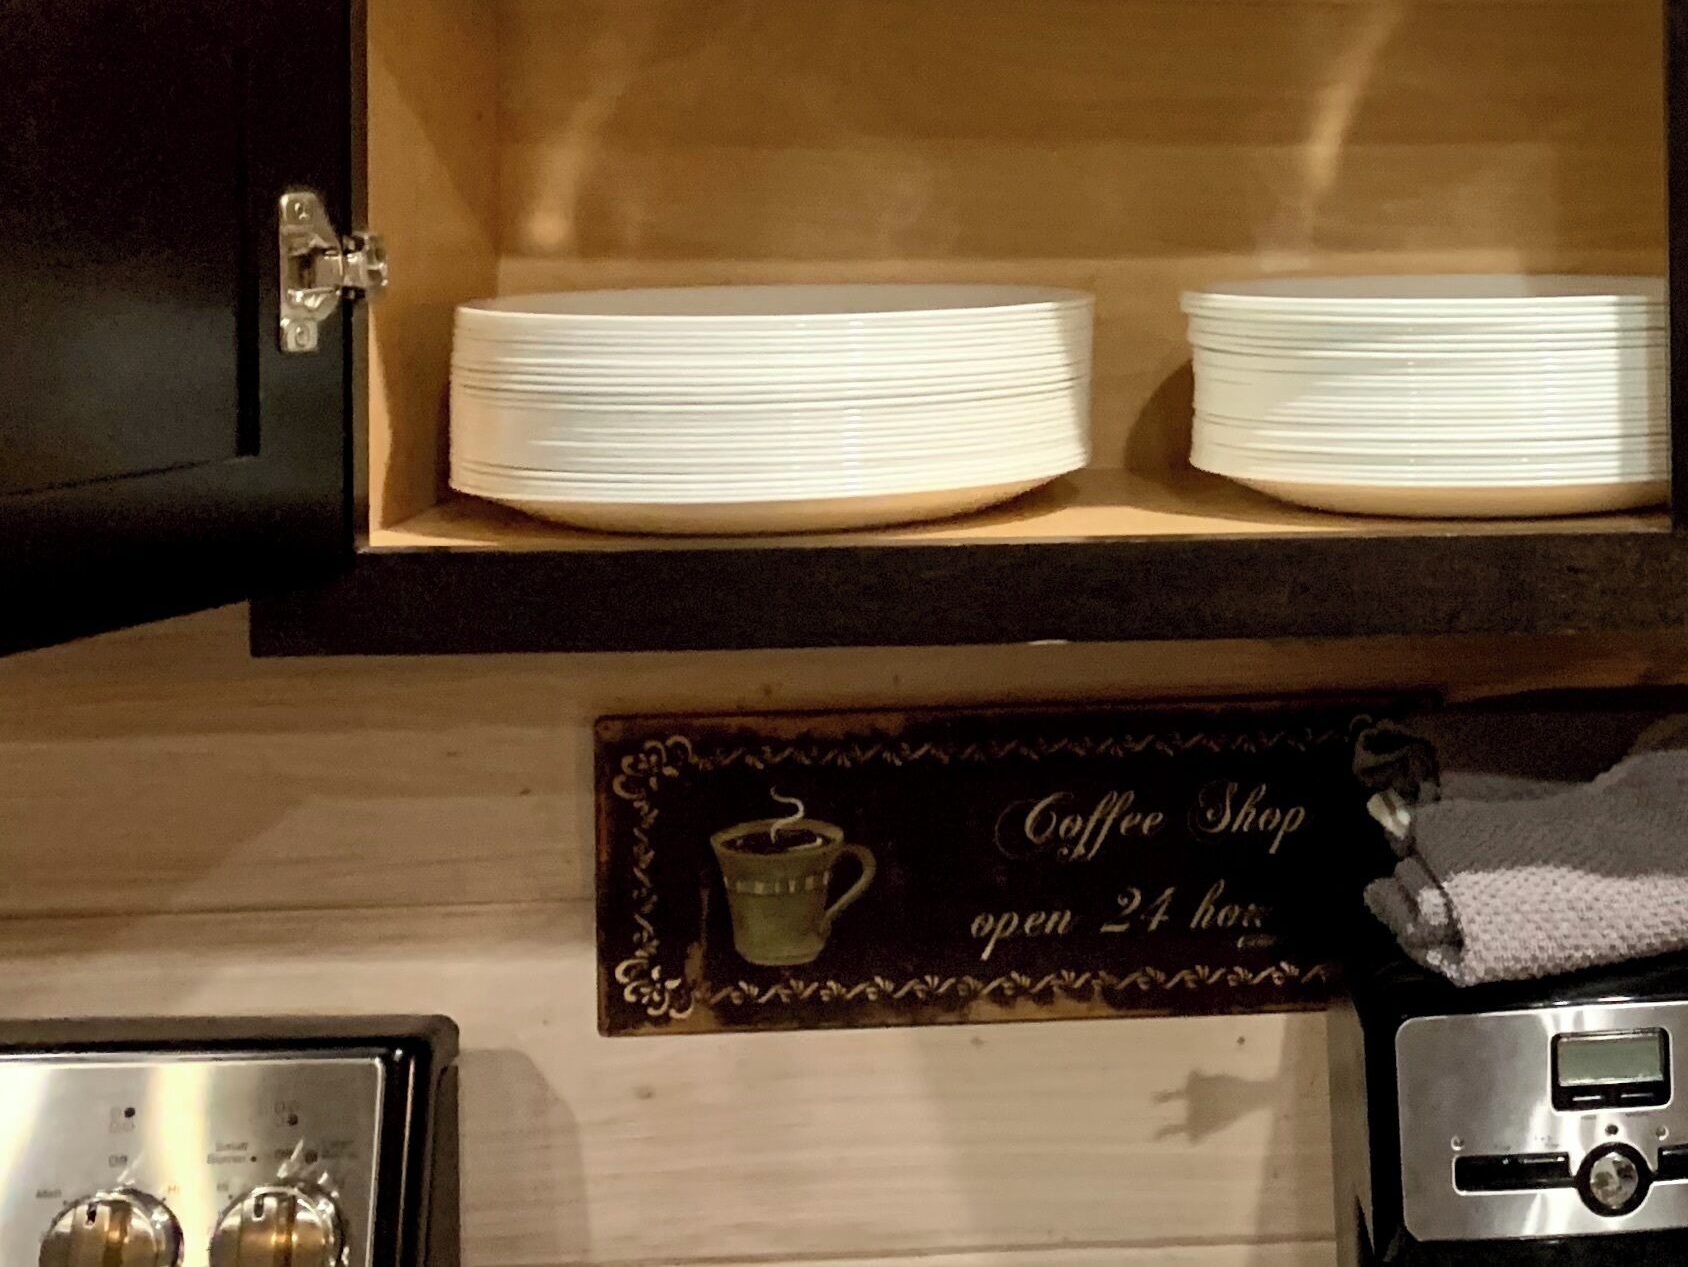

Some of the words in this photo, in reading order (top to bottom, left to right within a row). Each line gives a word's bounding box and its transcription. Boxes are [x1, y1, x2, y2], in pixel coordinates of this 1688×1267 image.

[997, 790, 1164, 861] Coffee
[1192, 780, 1307, 854] Shop
[970, 910, 1073, 961] open
[1101, 885, 1178, 933] 24
